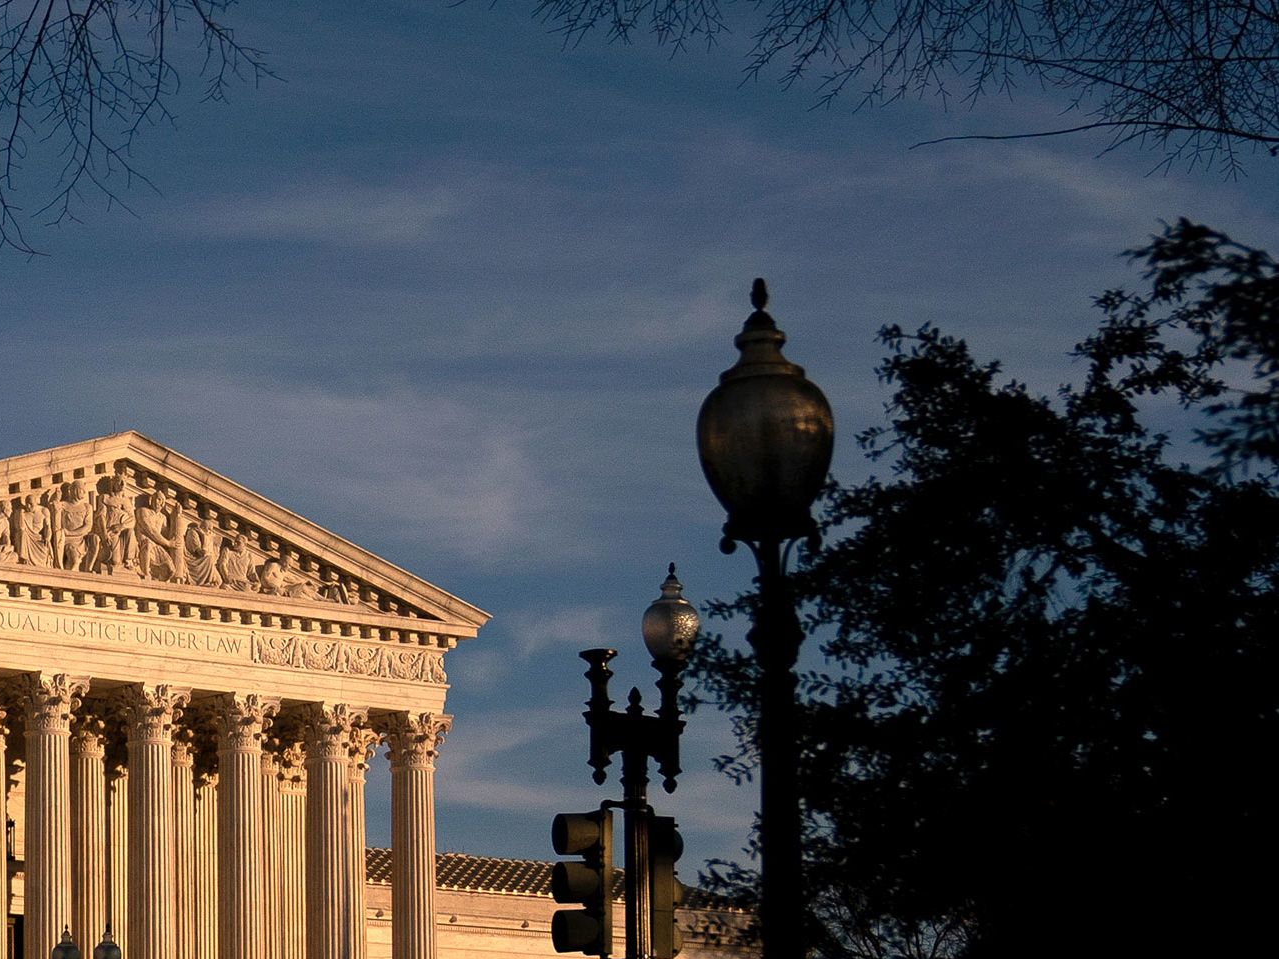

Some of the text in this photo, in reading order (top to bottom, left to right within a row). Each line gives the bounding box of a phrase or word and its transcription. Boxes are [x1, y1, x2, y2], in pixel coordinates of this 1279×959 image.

[51, 617, 126, 642] JUSTICE
[136, 627, 199, 650] UNDER
[206, 635, 242, 654] LAW
